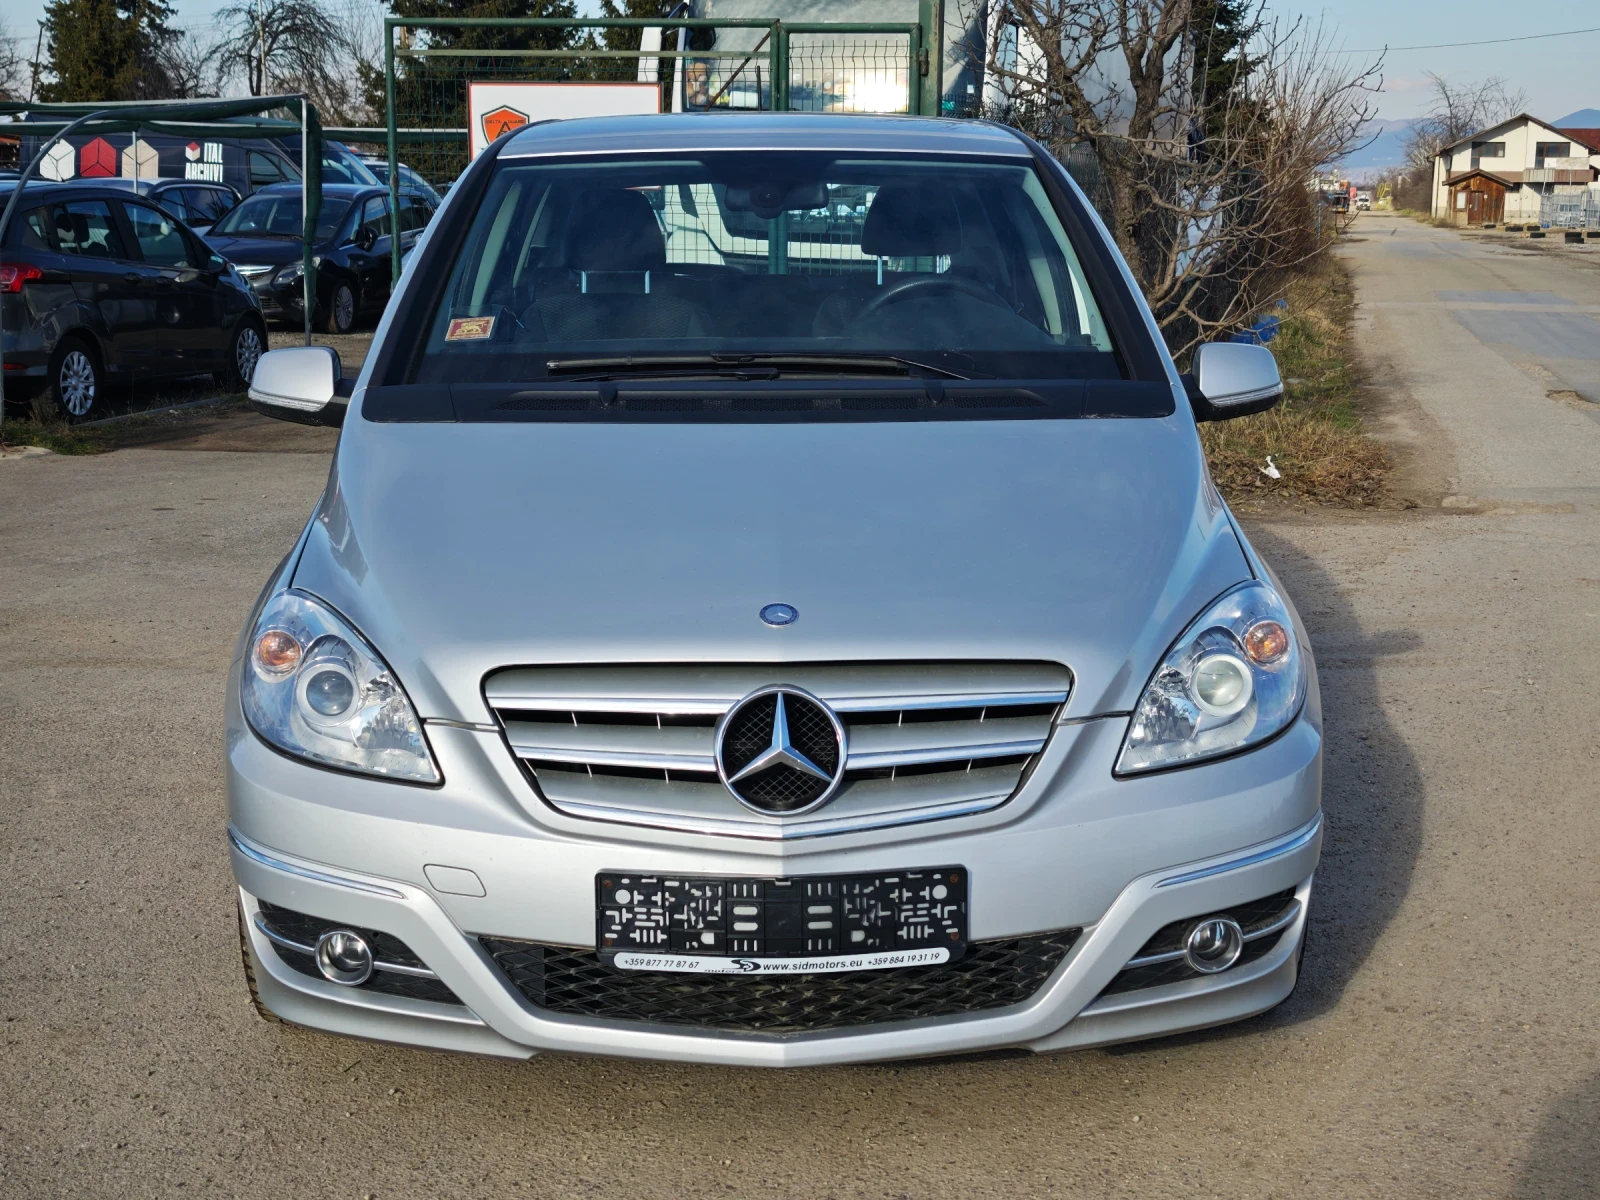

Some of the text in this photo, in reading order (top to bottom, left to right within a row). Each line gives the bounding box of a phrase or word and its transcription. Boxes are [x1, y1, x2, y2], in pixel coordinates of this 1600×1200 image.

[204, 142, 223, 163] ITAL
[185, 163, 223, 183] ARCHIVI
[624, 958, 700, 969] +359 877 77 87 67
[763, 960, 863, 970] www.sidmotors.eu
[867, 952, 940, 966] +359 884 19 31 19
